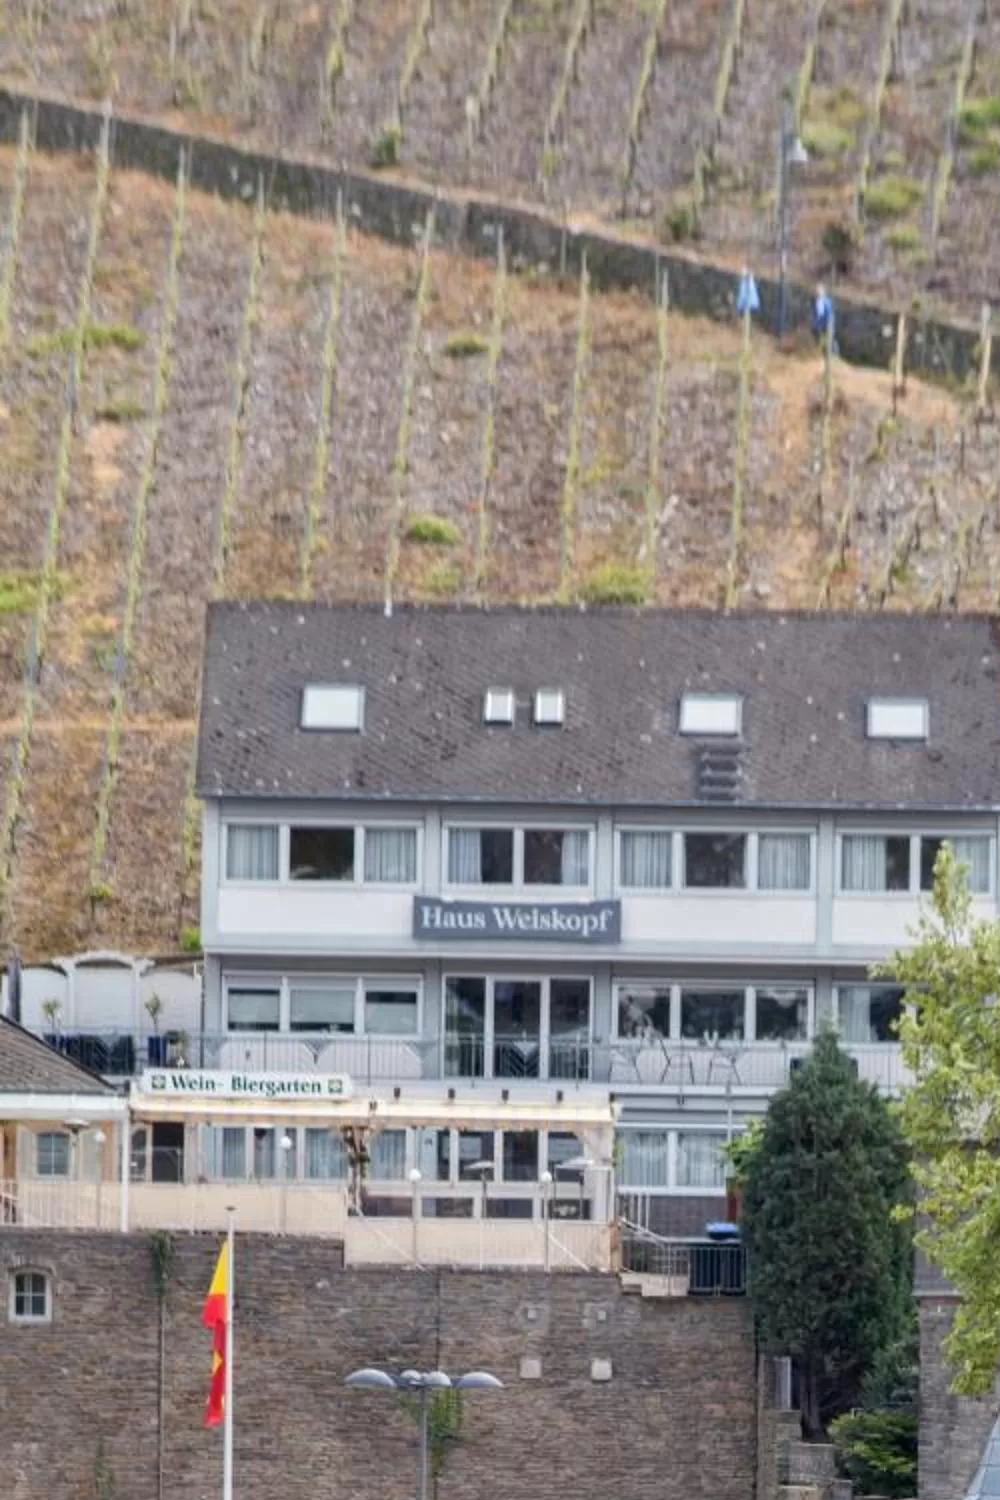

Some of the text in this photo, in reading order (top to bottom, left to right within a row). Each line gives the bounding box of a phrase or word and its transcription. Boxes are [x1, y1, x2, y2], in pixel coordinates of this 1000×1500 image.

[420, 905, 487, 930] Haus
[171, 1075, 322, 1096] Wein- Biergarten
